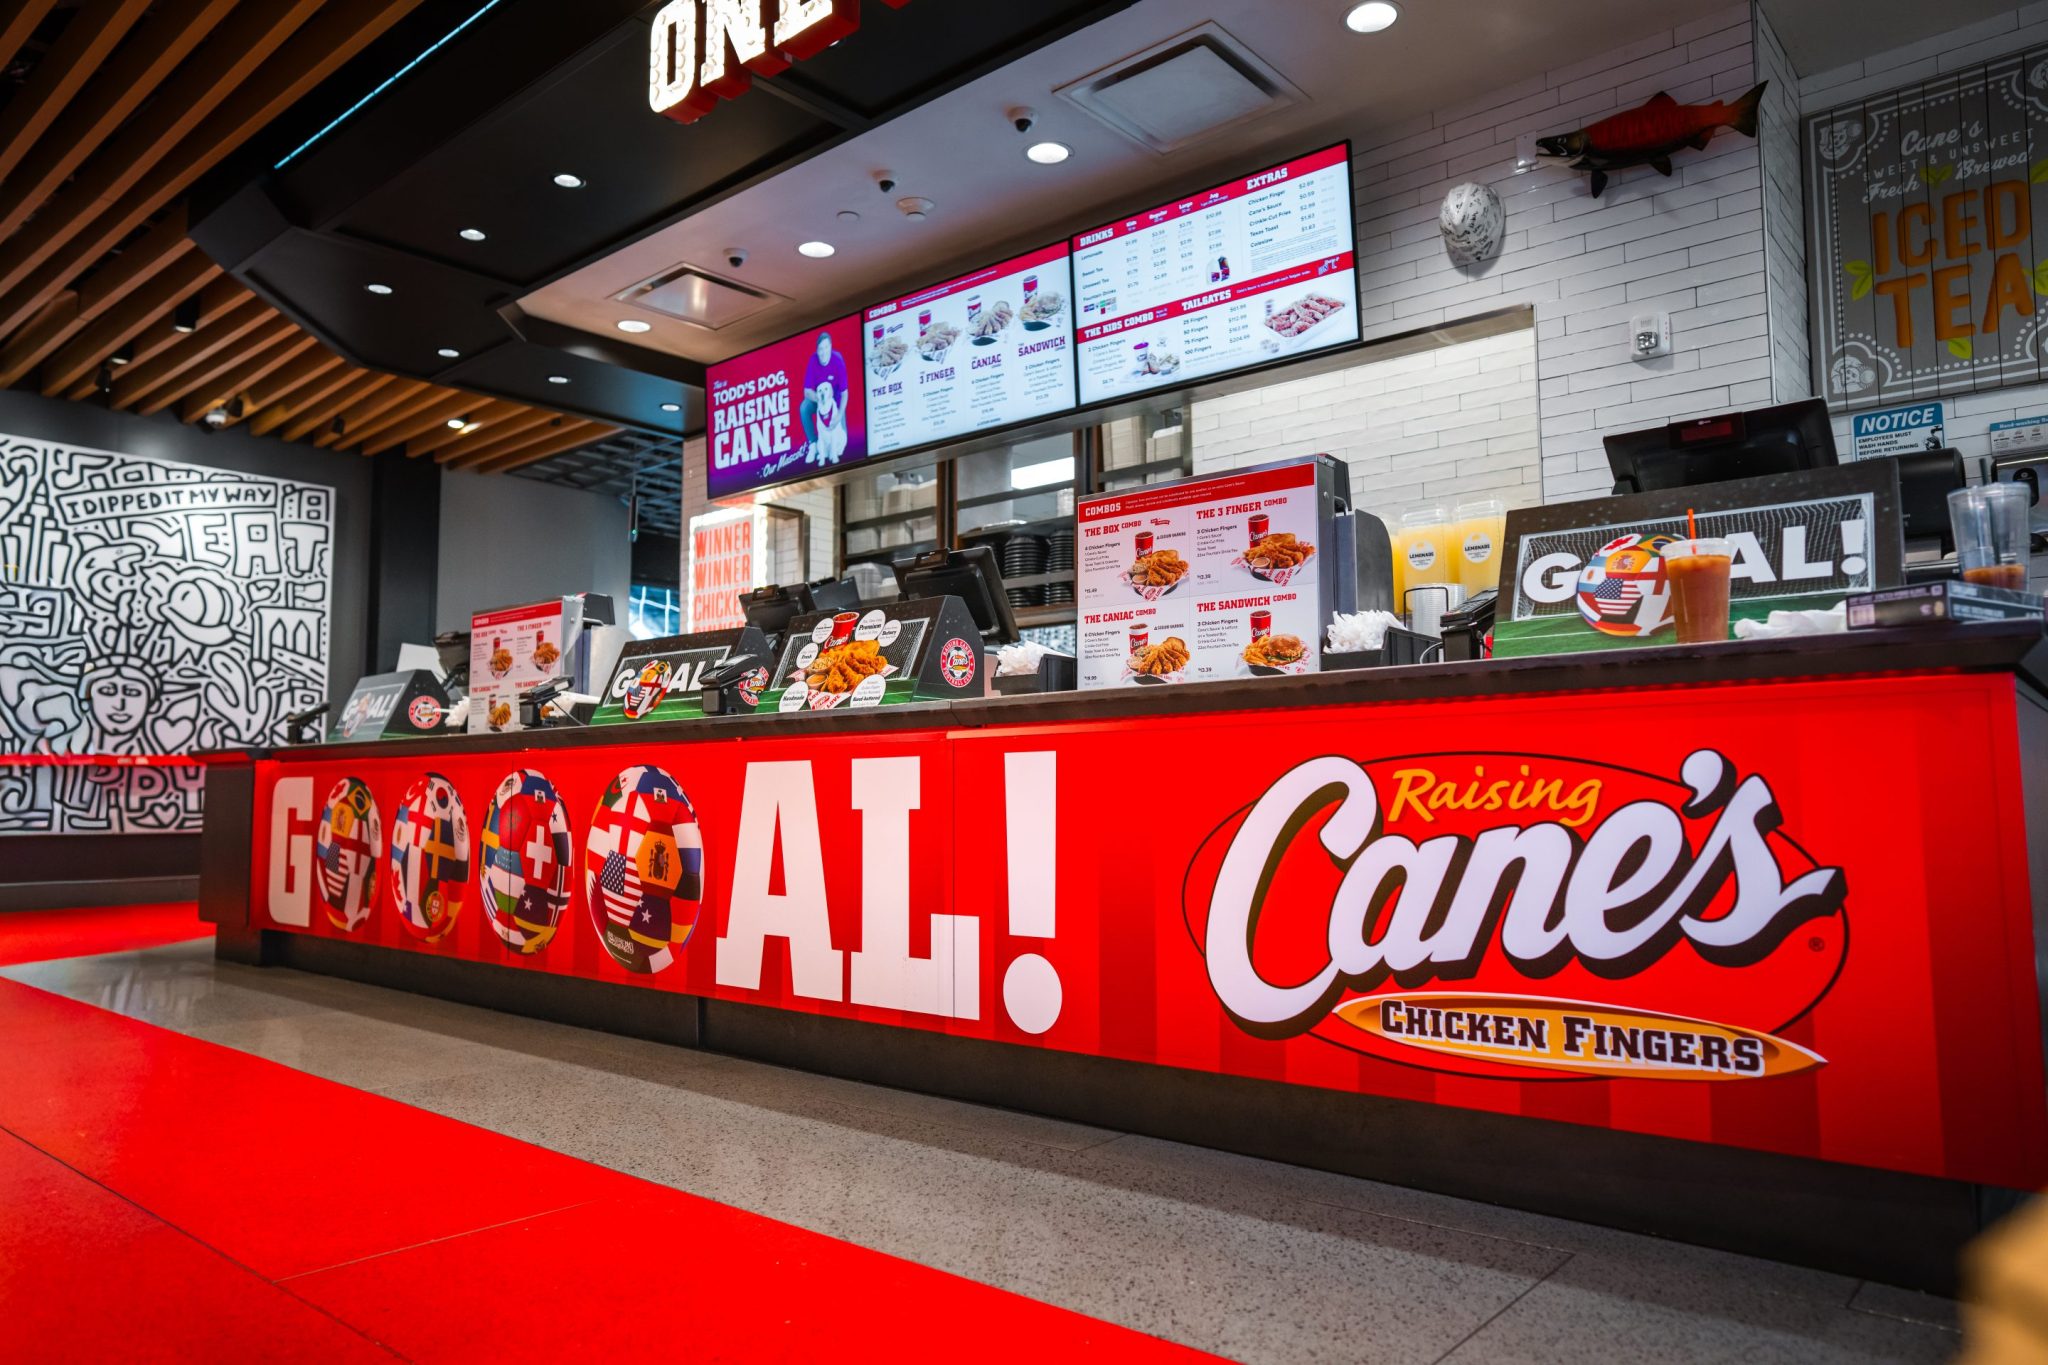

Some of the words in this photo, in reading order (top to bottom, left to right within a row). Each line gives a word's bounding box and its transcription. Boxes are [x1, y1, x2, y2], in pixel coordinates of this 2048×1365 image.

[1901, 120, 1983, 156] Cane's
[1863, 159, 1918, 182] SWEET
[1929, 154, 1938, 165] &
[1949, 128, 2034, 161] UNSWEET
[1246, 167, 1288, 190] EXTRAS
[1248, 195, 1269, 206] Chicken
[1269, 190, 1286, 200] Finger
[1862, 179, 1920, 204] Fresh
[1266, 201, 1282, 210] Sauce
[1080, 227, 1114, 247] DRINKS
[1871, 179, 2031, 276] ICED
[868, 302, 897, 318] COMBOS
[1181, 289, 1232, 311] TAILGATES
[1875, 252, 2034, 349] TEA
[1084, 326, 1101, 339] THE
[1102, 320, 1122, 333] KIDS
[1124, 312, 1154, 328] COMBO
[1190, 314, 1208, 324] Fingers
[1018, 336, 1066, 357] SANDWICH
[972, 354, 1002, 370] CANIAC
[920, 374, 924, 384] 3
[926, 367, 956, 384] FINGER
[713, 380, 755, 406] TODD'S
[758, 370, 788, 392] DOG,
[872, 388, 887, 398] THE
[888, 382, 903, 396] BOX
[714, 388, 790, 434] RAISING
[1860, 408, 1935, 434] NOTICE
[714, 413, 791, 470] CANE
[1858, 434, 1894, 444] EMPLOYEES
[1884, 443, 1919, 452] RETURNING
[84, 492, 162, 515] DIPPED
[166, 490, 184, 506] IT
[190, 488, 220, 504] MY
[224, 486, 272, 503] WAY
[1086, 502, 1121, 517] COMBOS
[1196, 510, 1215, 520] THE
[1226, 501, 1262, 516] FINGER
[1264, 497, 1287, 507] COMBO
[695, 522, 751, 560] WINNER
[1085, 526, 1101, 538] THE
[1103, 524, 1120, 534] BOX
[694, 554, 751, 591] WINNER
[1197, 602, 1216, 612] THE
[1218, 596, 1270, 610] SANDWICH
[1084, 615, 1100, 624] THE
[1103, 611, 1134, 622] CANIAC
[825, 634, 849, 649] Cane's
[1387, 765, 1603, 827] Raising
[1205, 748, 1842, 1030] Cane's
[1379, 999, 1548, 1053] CHICKEN
[1562, 1015, 1766, 1078] FINGERS
